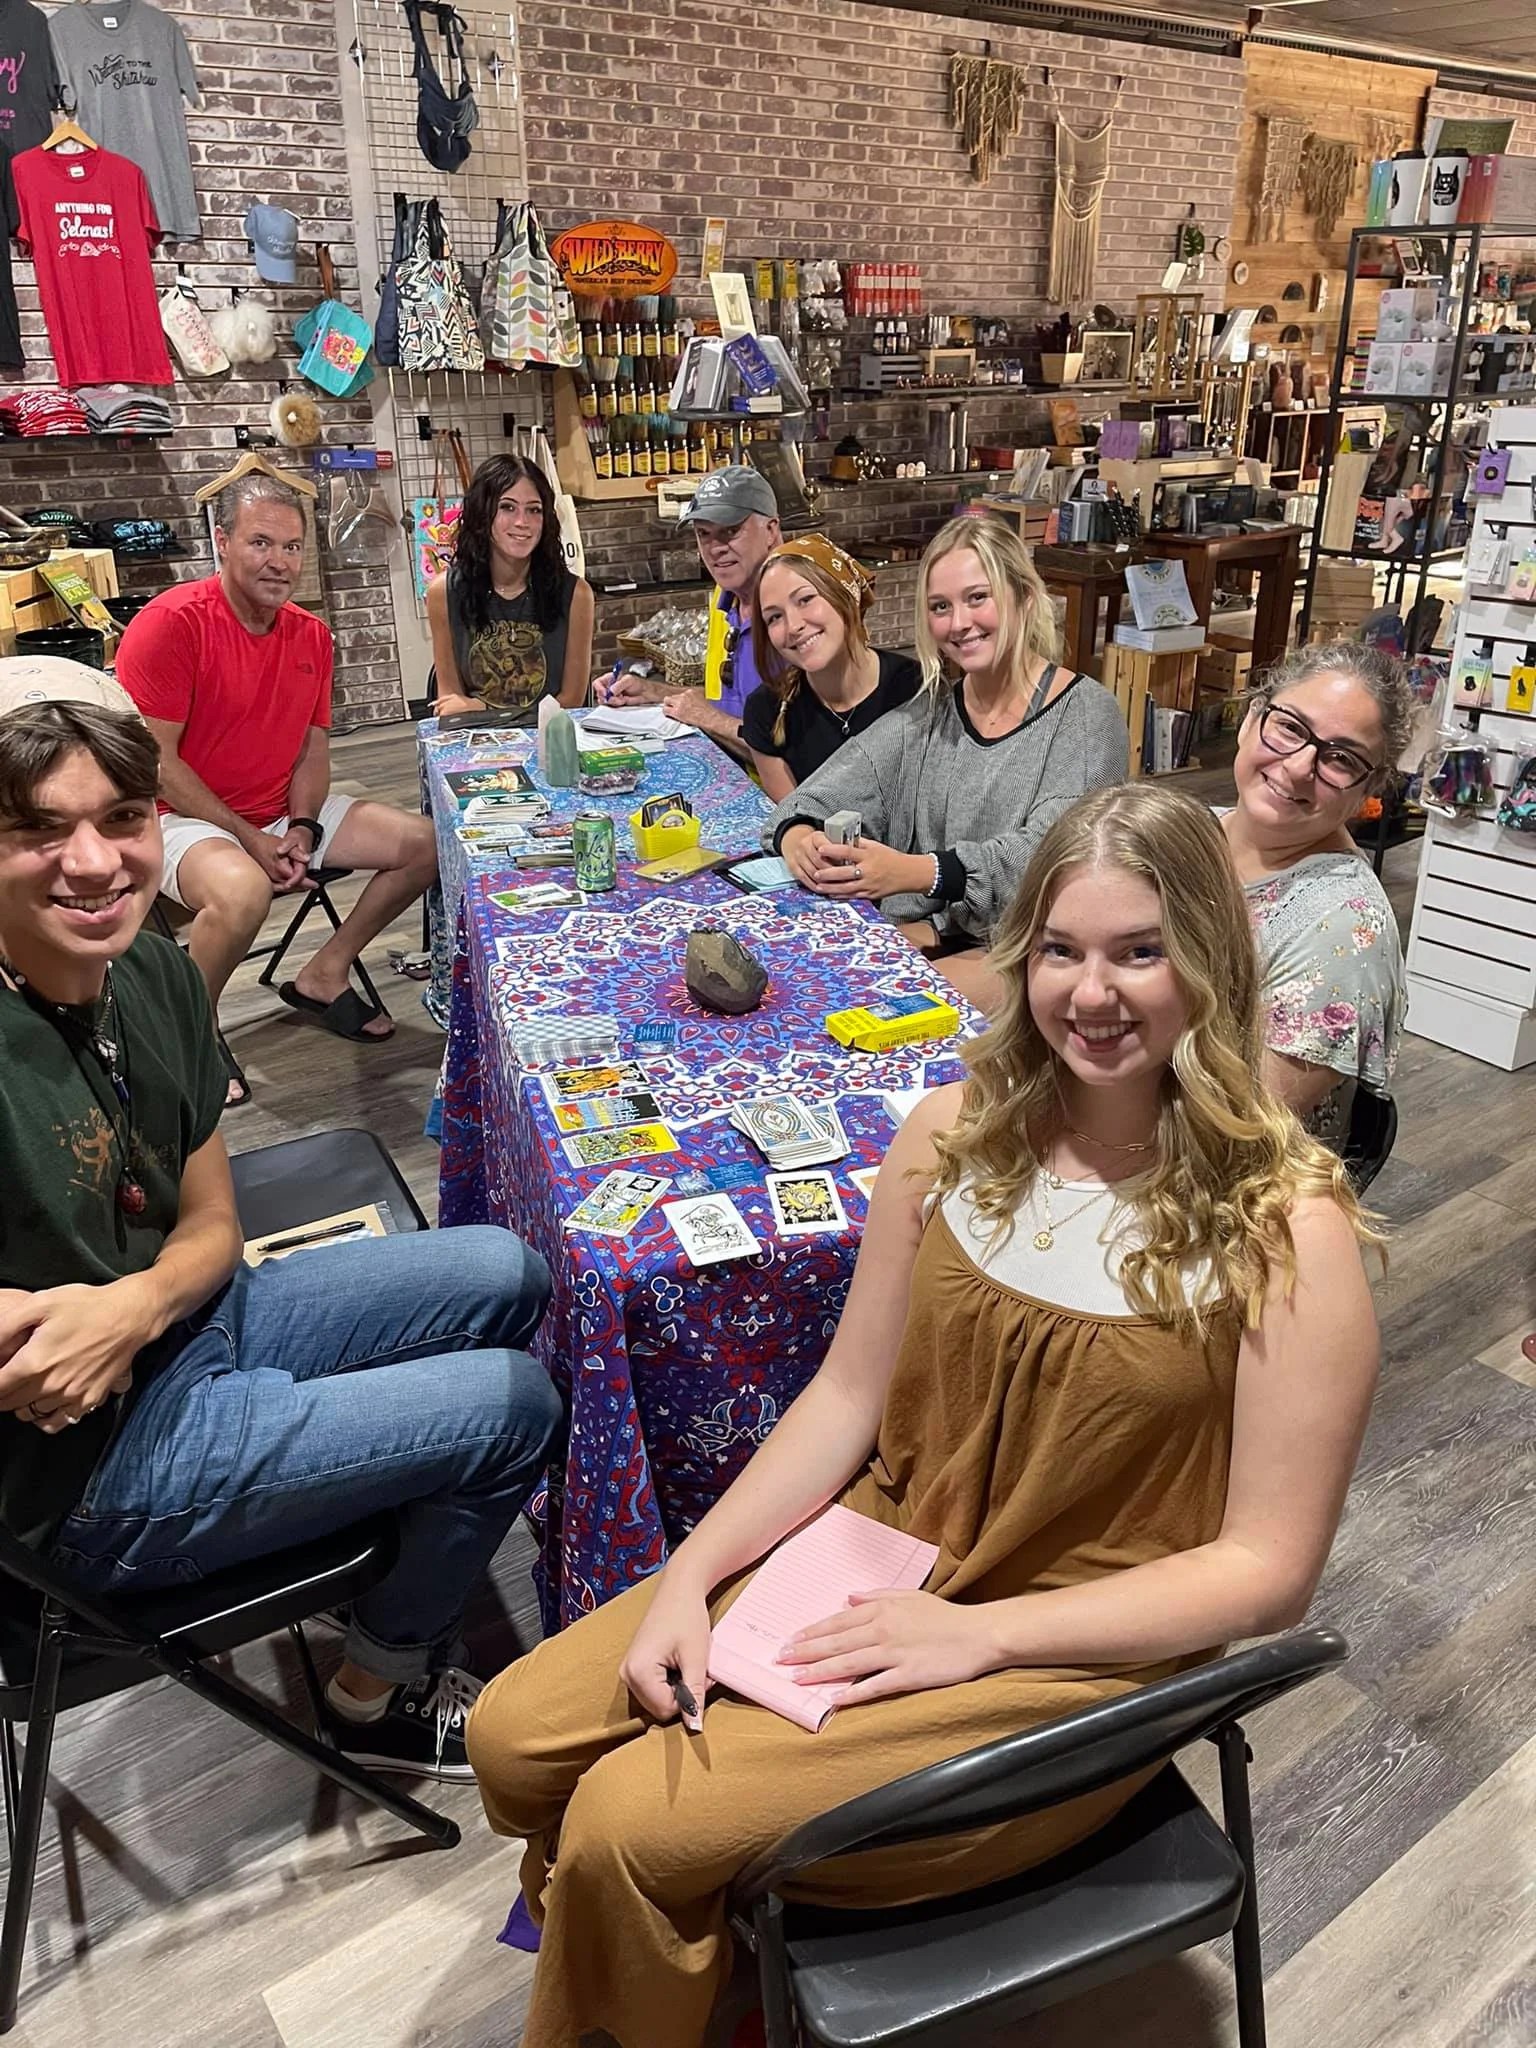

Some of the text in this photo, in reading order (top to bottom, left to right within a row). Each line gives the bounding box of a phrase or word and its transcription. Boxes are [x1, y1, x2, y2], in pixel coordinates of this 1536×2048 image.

[54, 202, 113, 215] ANYTHING FOR
[59, 214, 114, 240] Selenas!
[560, 237, 664, 276] WILD BERRY
